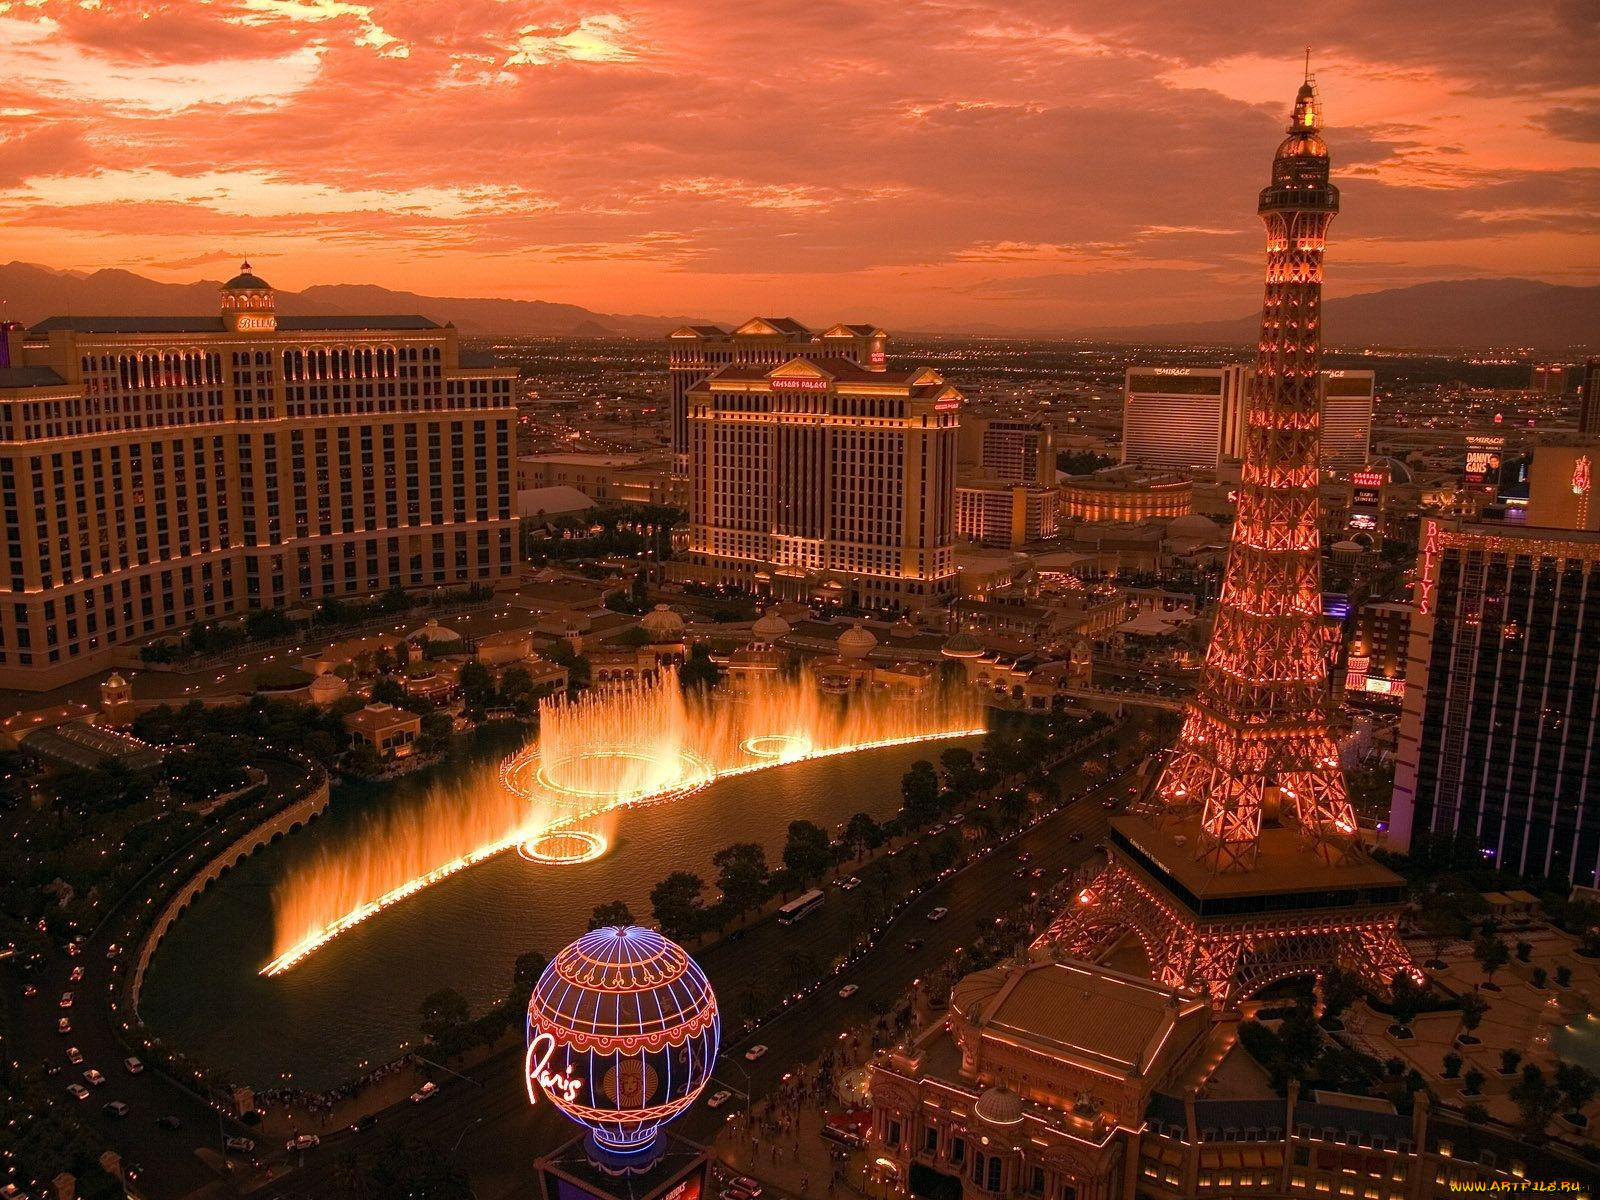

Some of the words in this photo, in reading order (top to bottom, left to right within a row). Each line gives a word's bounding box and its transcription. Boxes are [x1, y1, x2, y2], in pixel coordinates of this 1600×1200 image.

[1466, 452, 1493, 464] DANNY
[1465, 462, 1487, 473] GANS
[525, 1032, 582, 1105] Paris
